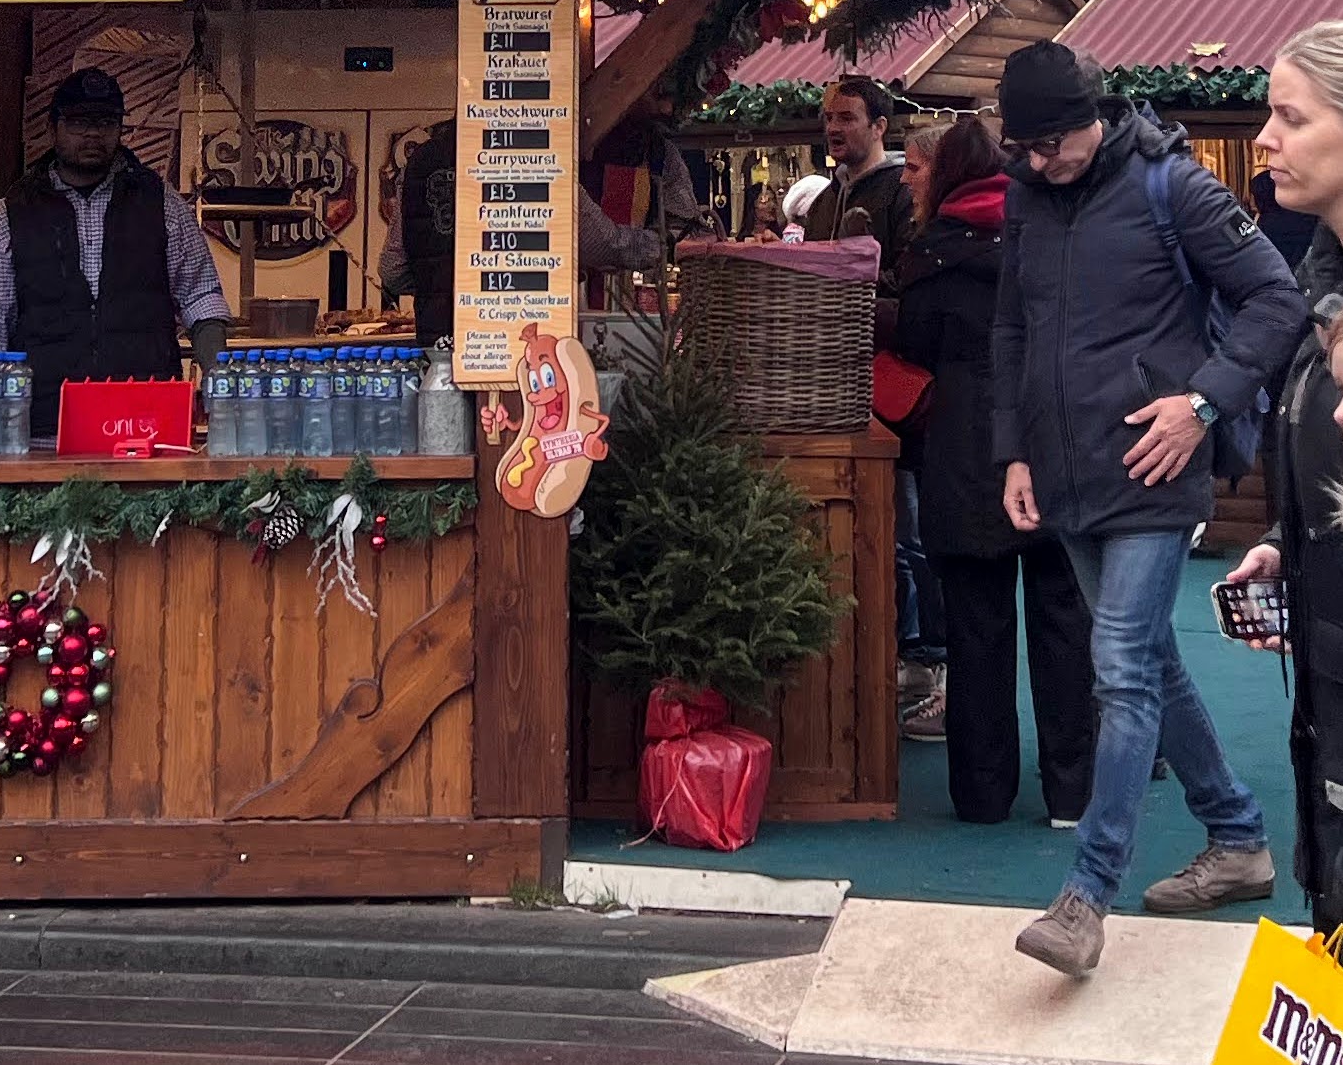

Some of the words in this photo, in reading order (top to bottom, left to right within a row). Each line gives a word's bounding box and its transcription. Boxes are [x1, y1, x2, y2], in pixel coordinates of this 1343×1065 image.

[484, 7, 552, 21] Bratwurst
[490, 33, 514, 51] £11
[488, 54, 548, 68] Krakauer
[489, 82, 513, 99] £11
[466, 104, 568, 118] Kasebockwurst
[490, 131, 513, 148] £11
[477, 151, 556, 168] Currywurst
[489, 184, 516, 201] £13
[478, 205, 554, 221] Frankfurter
[489, 232, 517, 251] £10
[470, 253, 500, 267] Beef
[505, 253, 562, 269] Sausage
[488, 272, 515, 291] £12
[459, 295, 471, 305] All
[474, 295, 500, 305] served
[503, 295, 522, 305] with
[488, 308, 517, 321] Crispy
[519, 309, 549, 319] Onions
